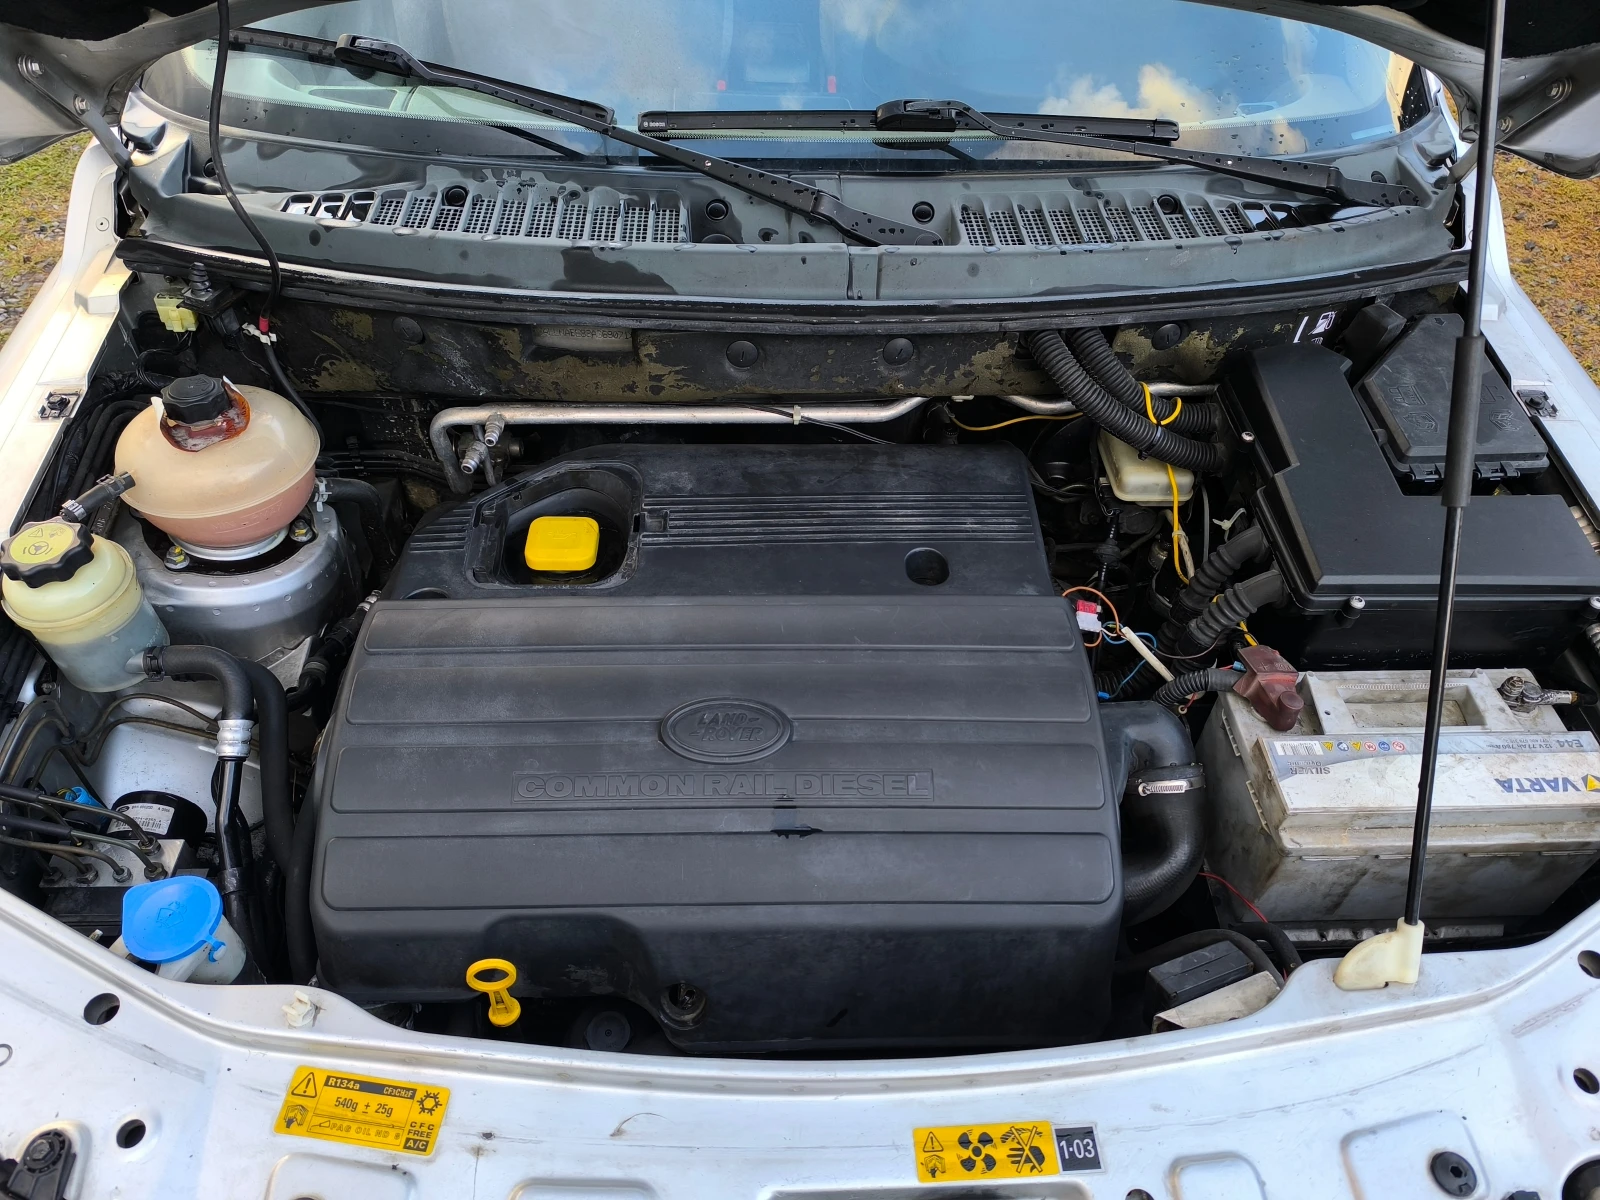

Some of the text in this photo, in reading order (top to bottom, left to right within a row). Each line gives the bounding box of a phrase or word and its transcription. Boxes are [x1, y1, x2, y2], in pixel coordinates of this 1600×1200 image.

[698, 712, 748, 726] LAND
[701, 726, 764, 741] ROVER
[1556, 738, 1584, 748] E44
[516, 773, 930, 798] COMMON RAIL DIESEL
[1494, 777, 1581, 793] VARTA
[328, 1077, 360, 1090] R134a
[334, 1096, 358, 1112] 540g
[374, 1102, 393, 1118] 25g
[354, 1126, 371, 1137] OIL
[407, 1129, 432, 1138] FREE
[405, 1140, 427, 1150] A/C
